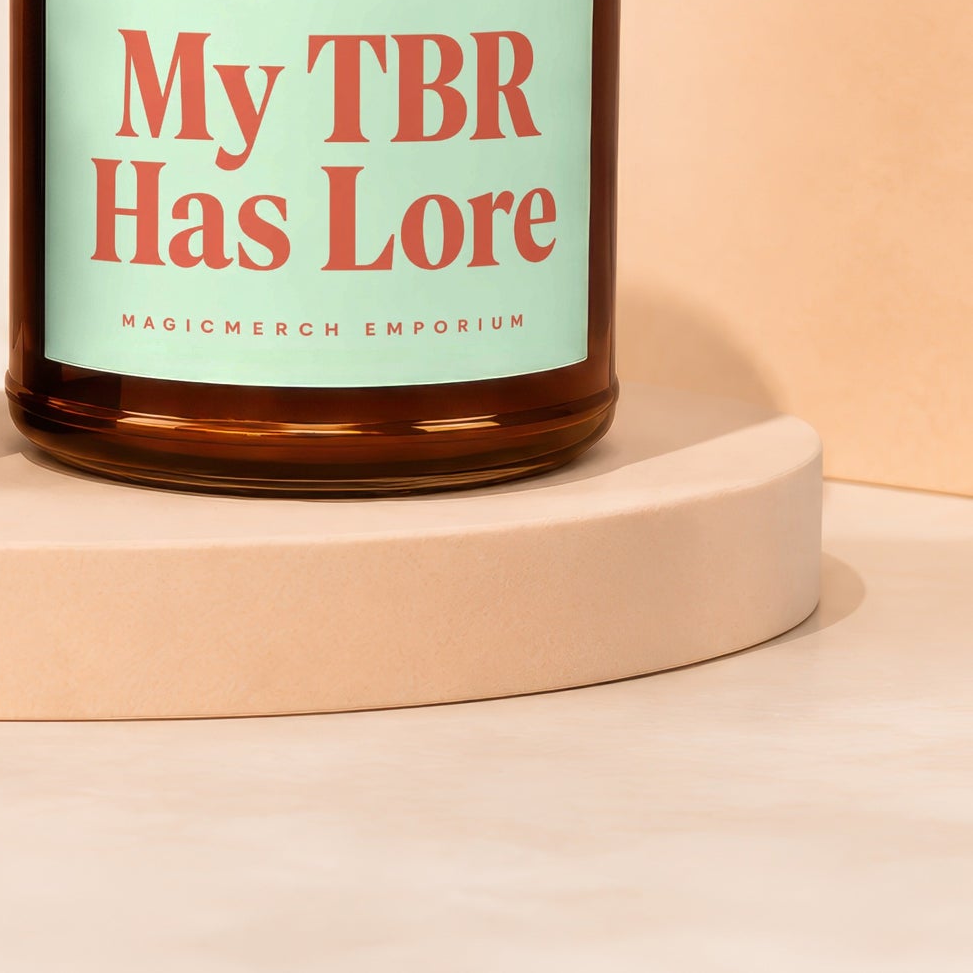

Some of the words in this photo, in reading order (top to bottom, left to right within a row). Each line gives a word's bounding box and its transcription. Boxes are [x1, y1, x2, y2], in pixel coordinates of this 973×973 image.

[115, 29, 285, 172] My
[307, 31, 542, 144] TBR
[90, 158, 292, 272] Has
[320, 166, 557, 272] Lore
[121, 313, 339, 337] MAGICMERCH
[364, 314, 525, 337] EMPORIUM
